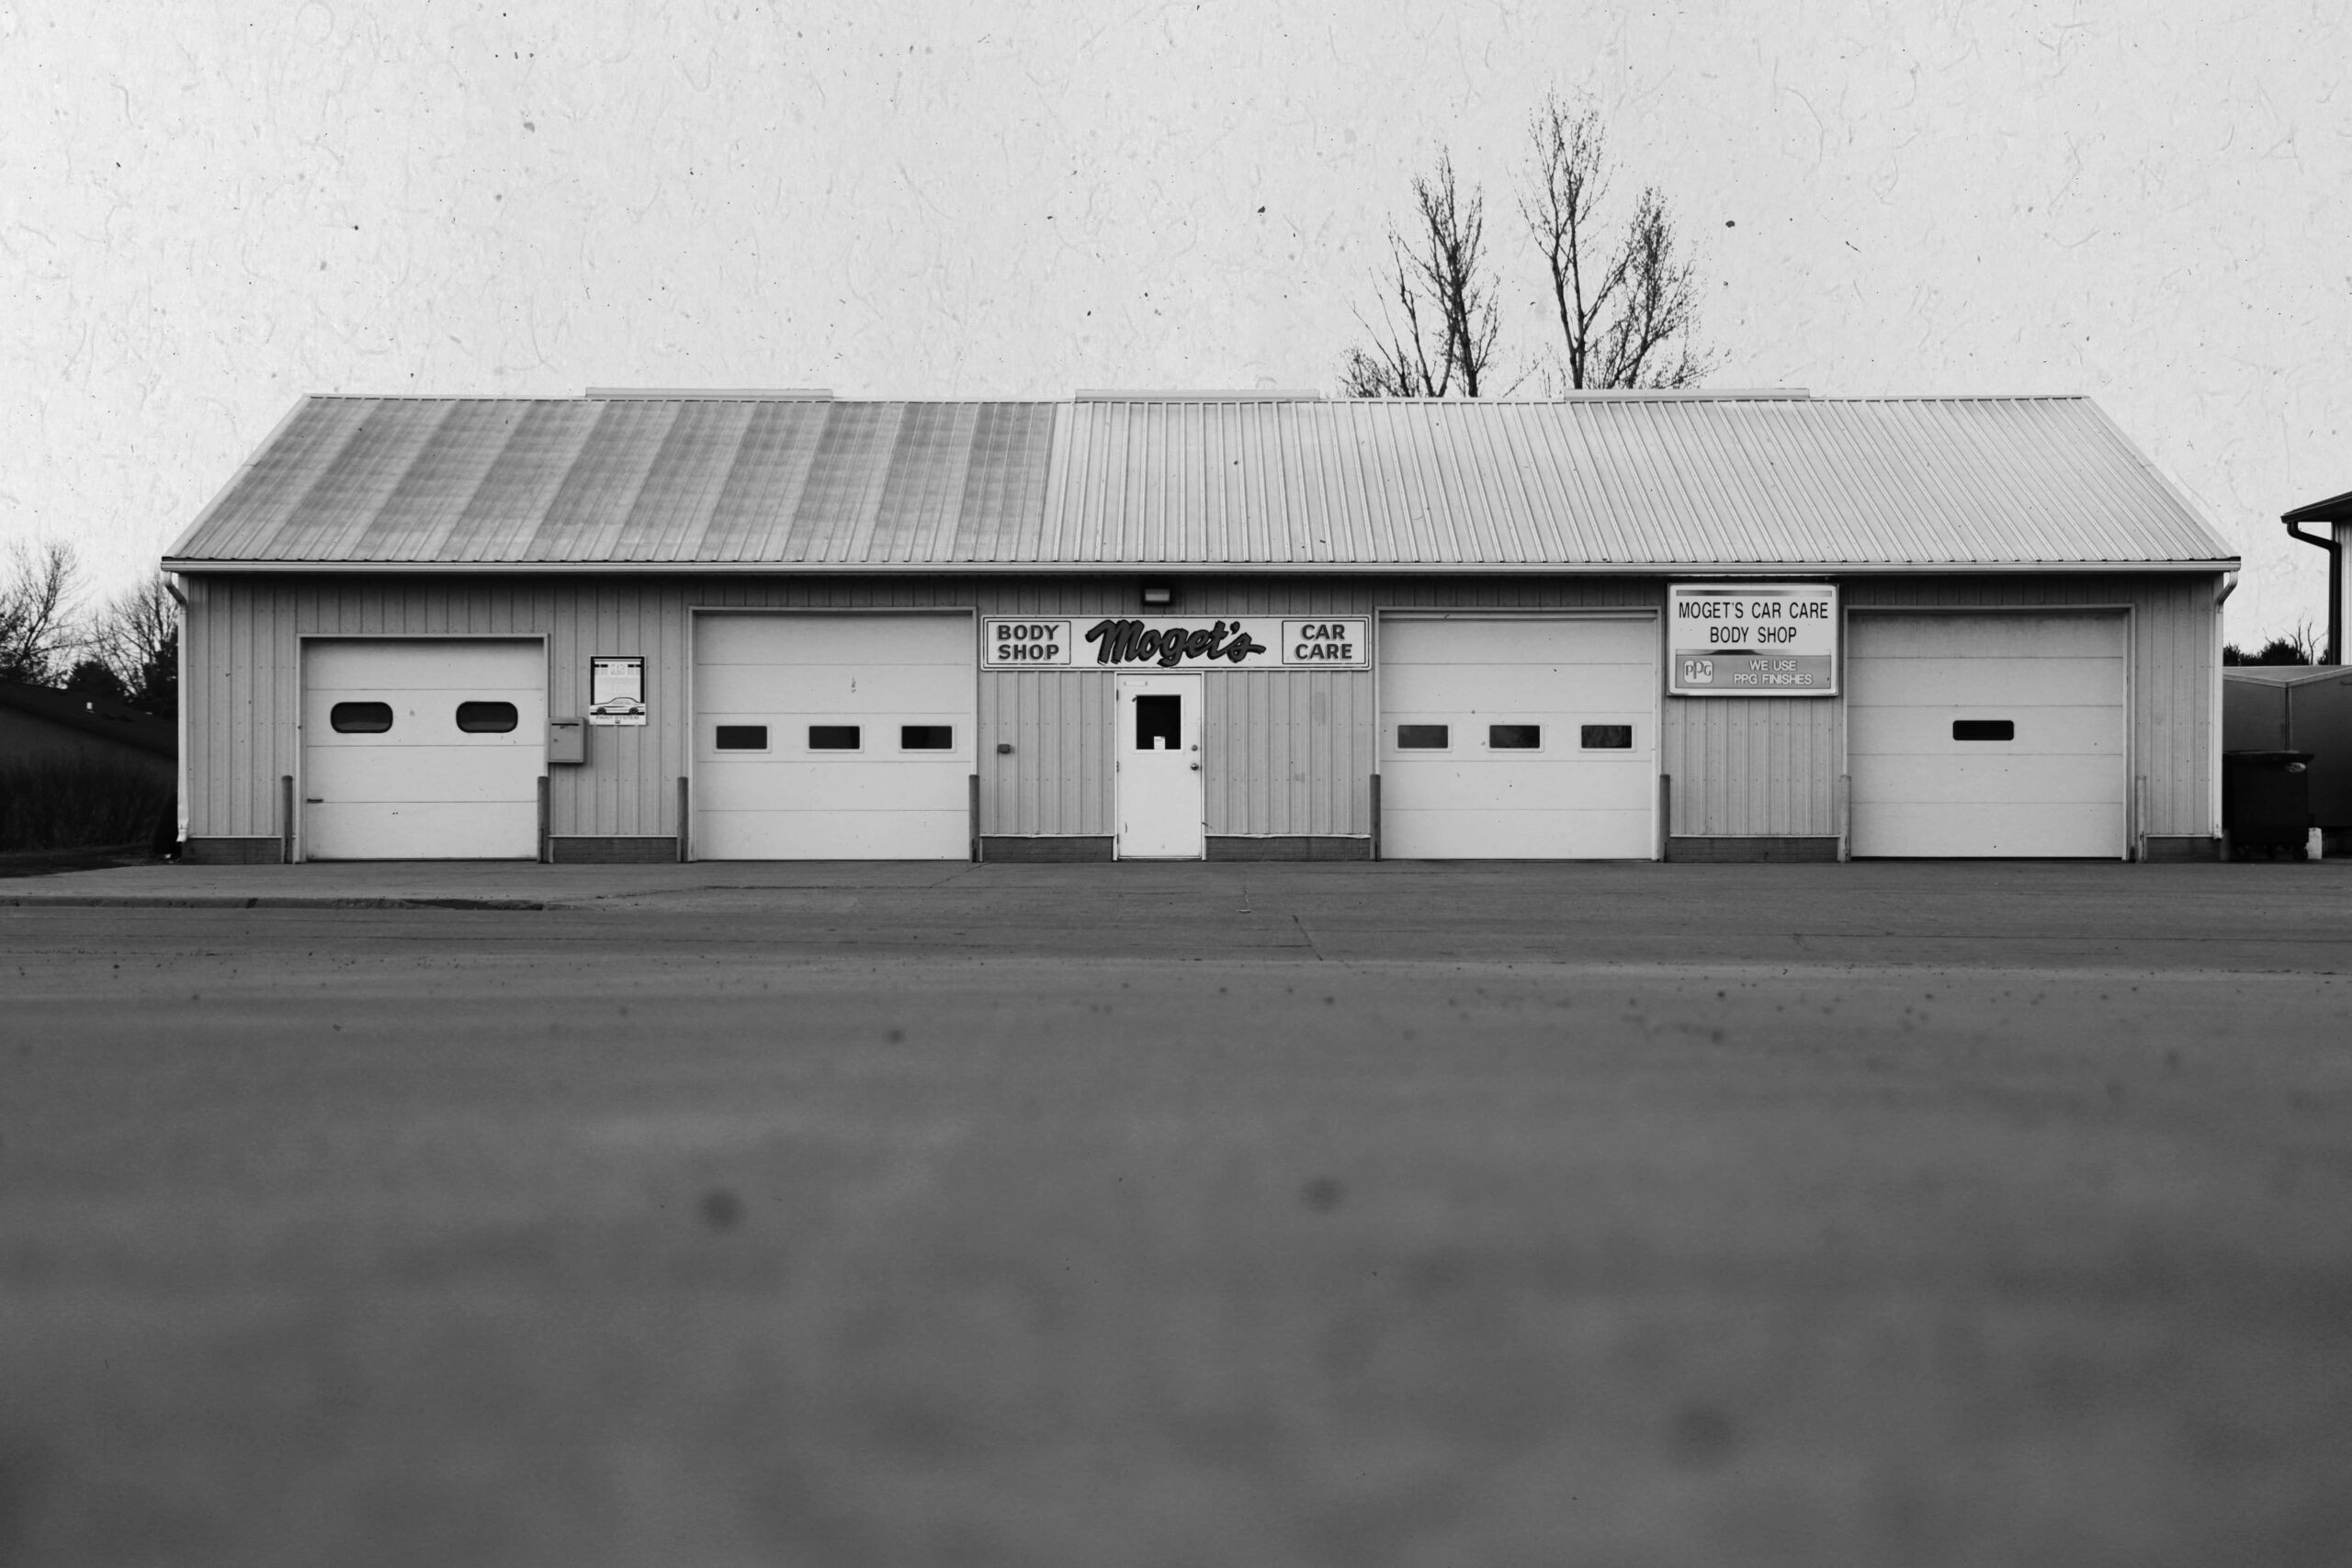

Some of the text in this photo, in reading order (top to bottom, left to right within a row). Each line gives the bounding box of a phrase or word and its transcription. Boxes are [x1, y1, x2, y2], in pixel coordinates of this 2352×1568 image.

[1679, 602, 1828, 618] MOGET'S CAR CARE
[997, 625, 1059, 640] BODY
[1301, 624, 1345, 640] CAR
[1710, 626, 1797, 643] BODY SHOP
[1085, 619, 1267, 668] Moget's
[1295, 643, 1352, 660] CARE
[998, 644, 1059, 660] SHOP
[1685, 660, 1712, 680] PPG
[1749, 660, 1796, 671] WE USE
[1734, 673, 1813, 684] PPG FINISHES
